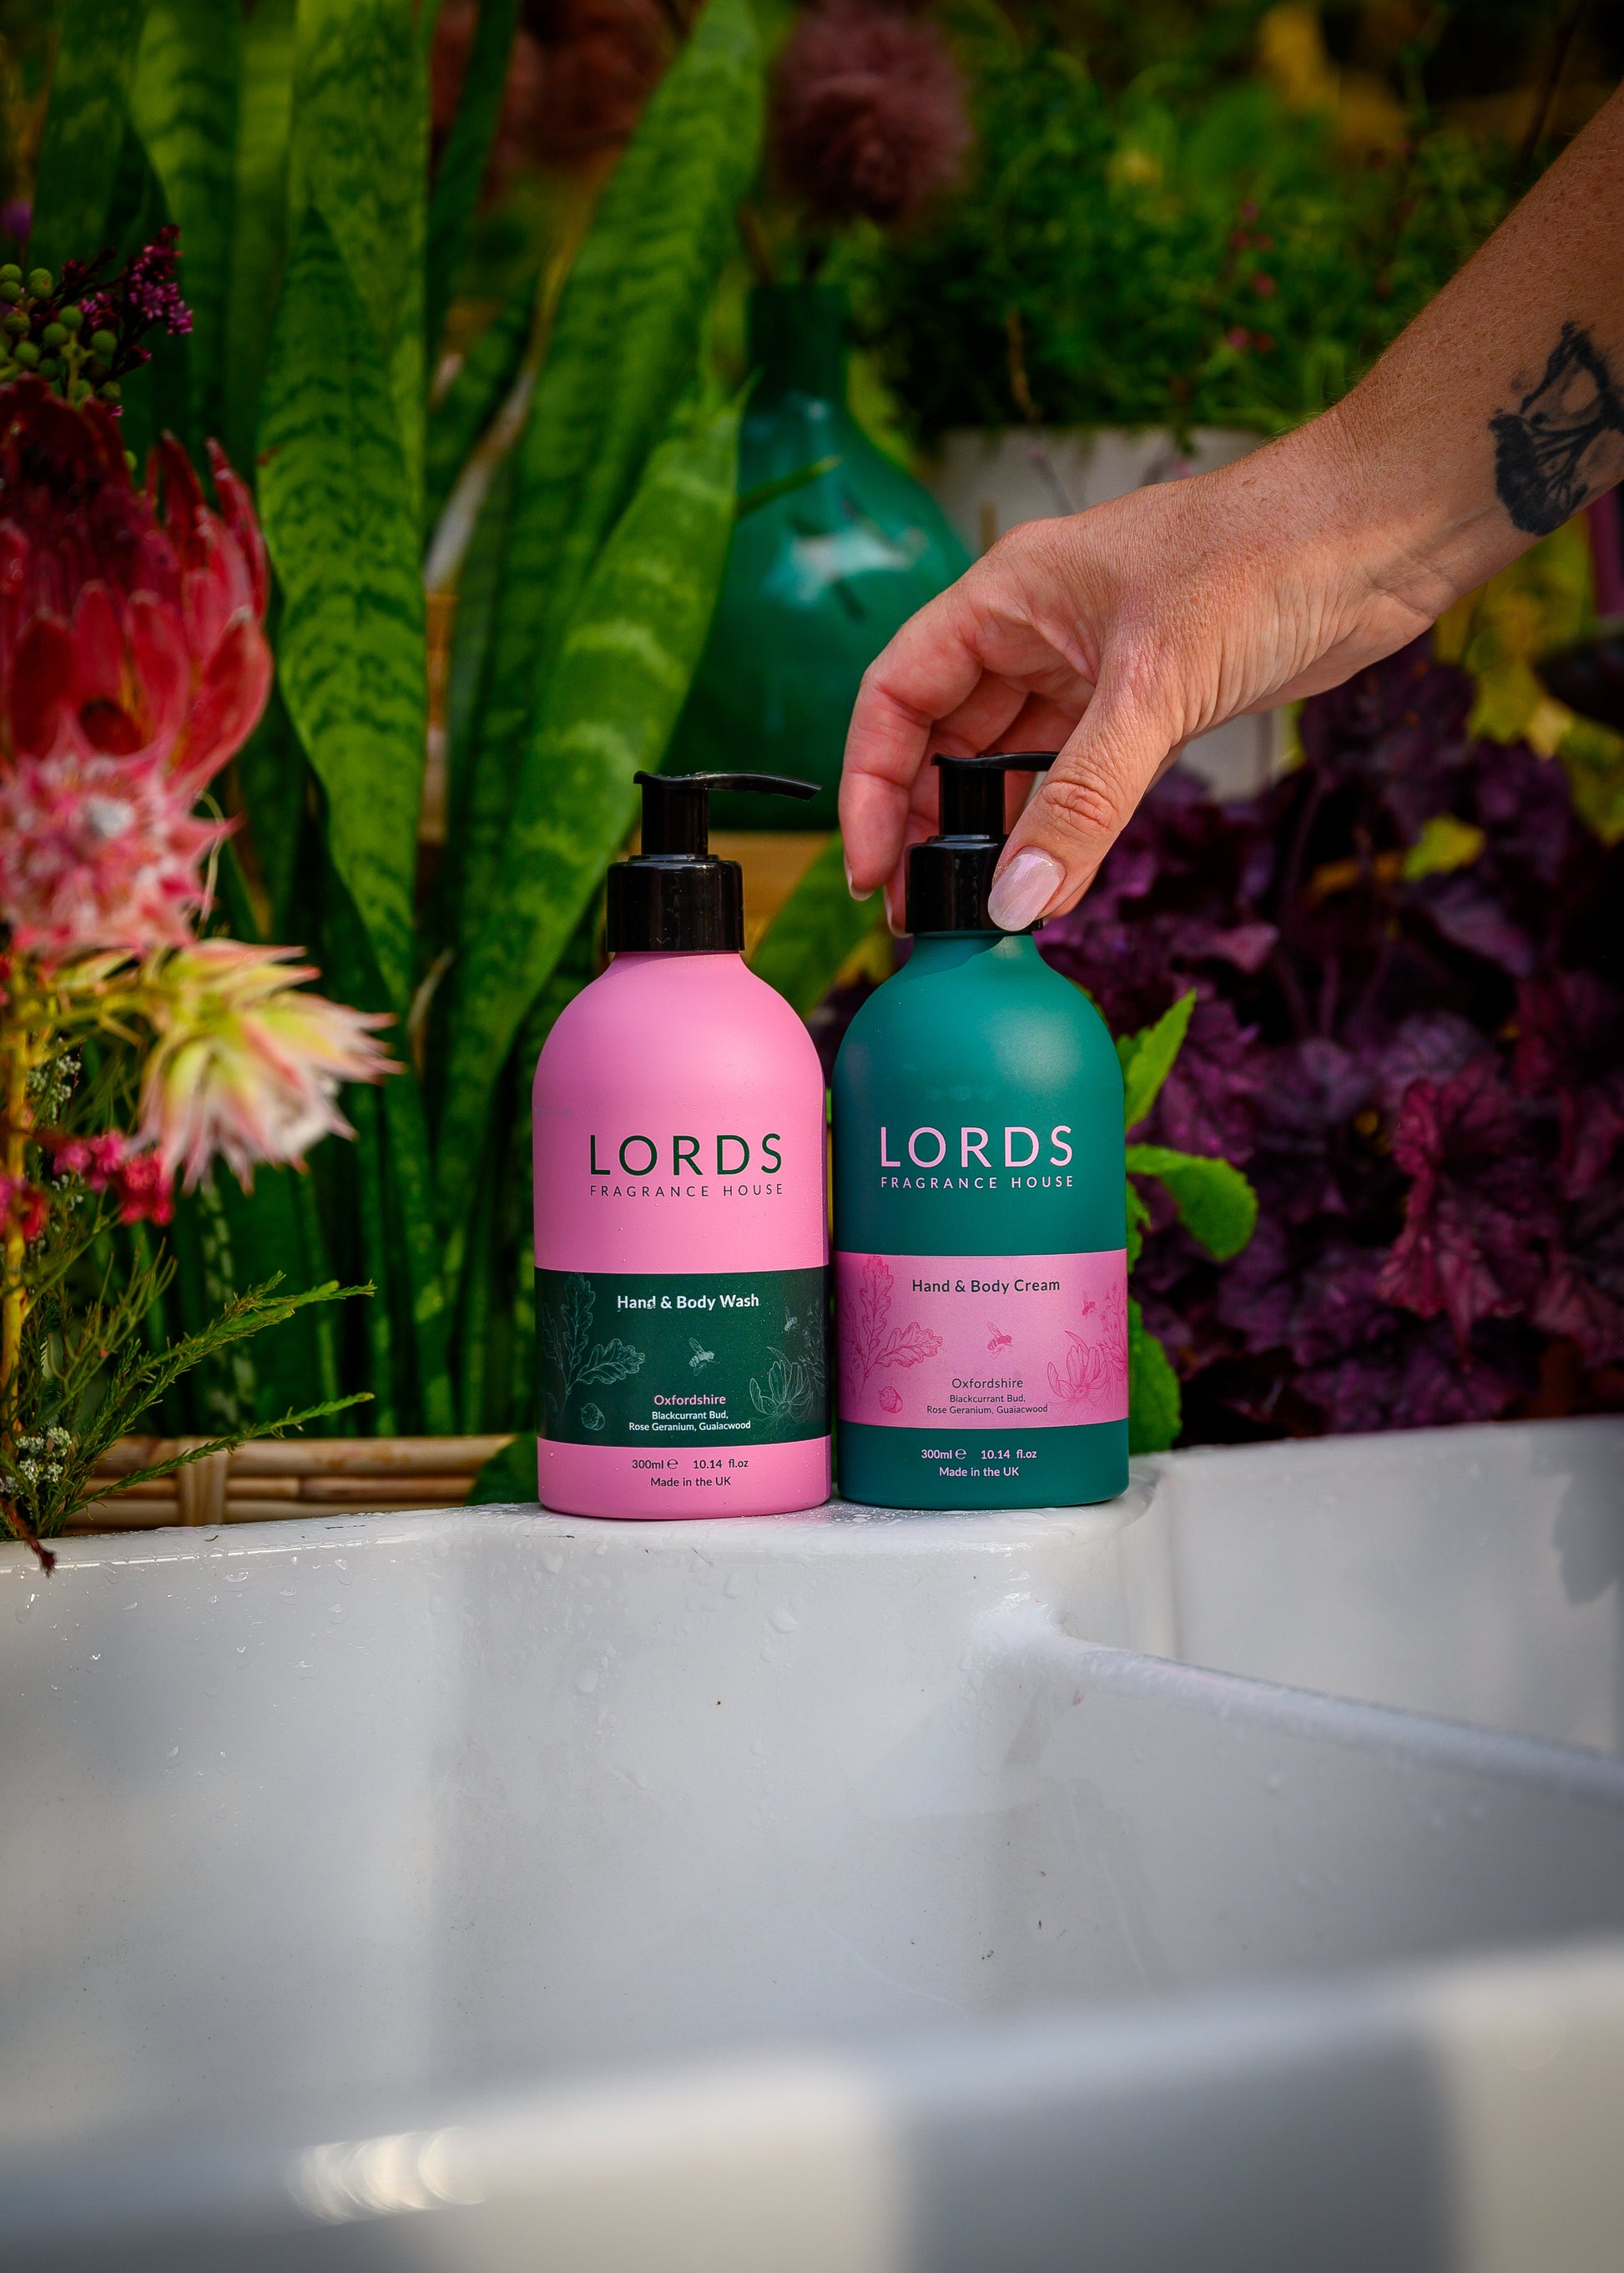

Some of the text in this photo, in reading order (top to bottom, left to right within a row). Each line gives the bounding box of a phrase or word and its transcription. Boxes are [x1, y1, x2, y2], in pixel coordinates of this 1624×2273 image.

[880, 1125, 1073, 1168] LORDS
[589, 1133, 782, 1177] LORDS
[881, 1175, 1073, 1190] FRAGRANCE HOUSE
[590, 1183, 783, 1197] FRAGRANCE HOUSE
[912, 1278, 1061, 1295] Hand & Body Cream
[618, 1293, 759, 1311] Hand & Body Wash
[951, 1378, 1024, 1389] Oxfordshire
[653, 1394, 726, 1406] Oxfordshire
[950, 1394, 1005, 1404] Blackcurrant
[652, 1410, 729, 1421] Blackcurrant Bud,
[926, 1404, 1048, 1416] Rose Geranium, Guaiacwood
[628, 1420, 751, 1433] Rose Geranium, Guaiacwood
[920, 1449, 952, 1459] 300ml
[981, 1449, 1011, 1459] 10.14
[1016, 1449, 1037, 1459] fl.oz
[632, 1459, 664, 1469] 300ml
[693, 1459, 723, 1469] 10.14
[728, 1459, 749, 1469] fl.oz
[939, 1466, 1020, 1477] Made in the UK
[650, 1476, 731, 1487] Made in the UK
